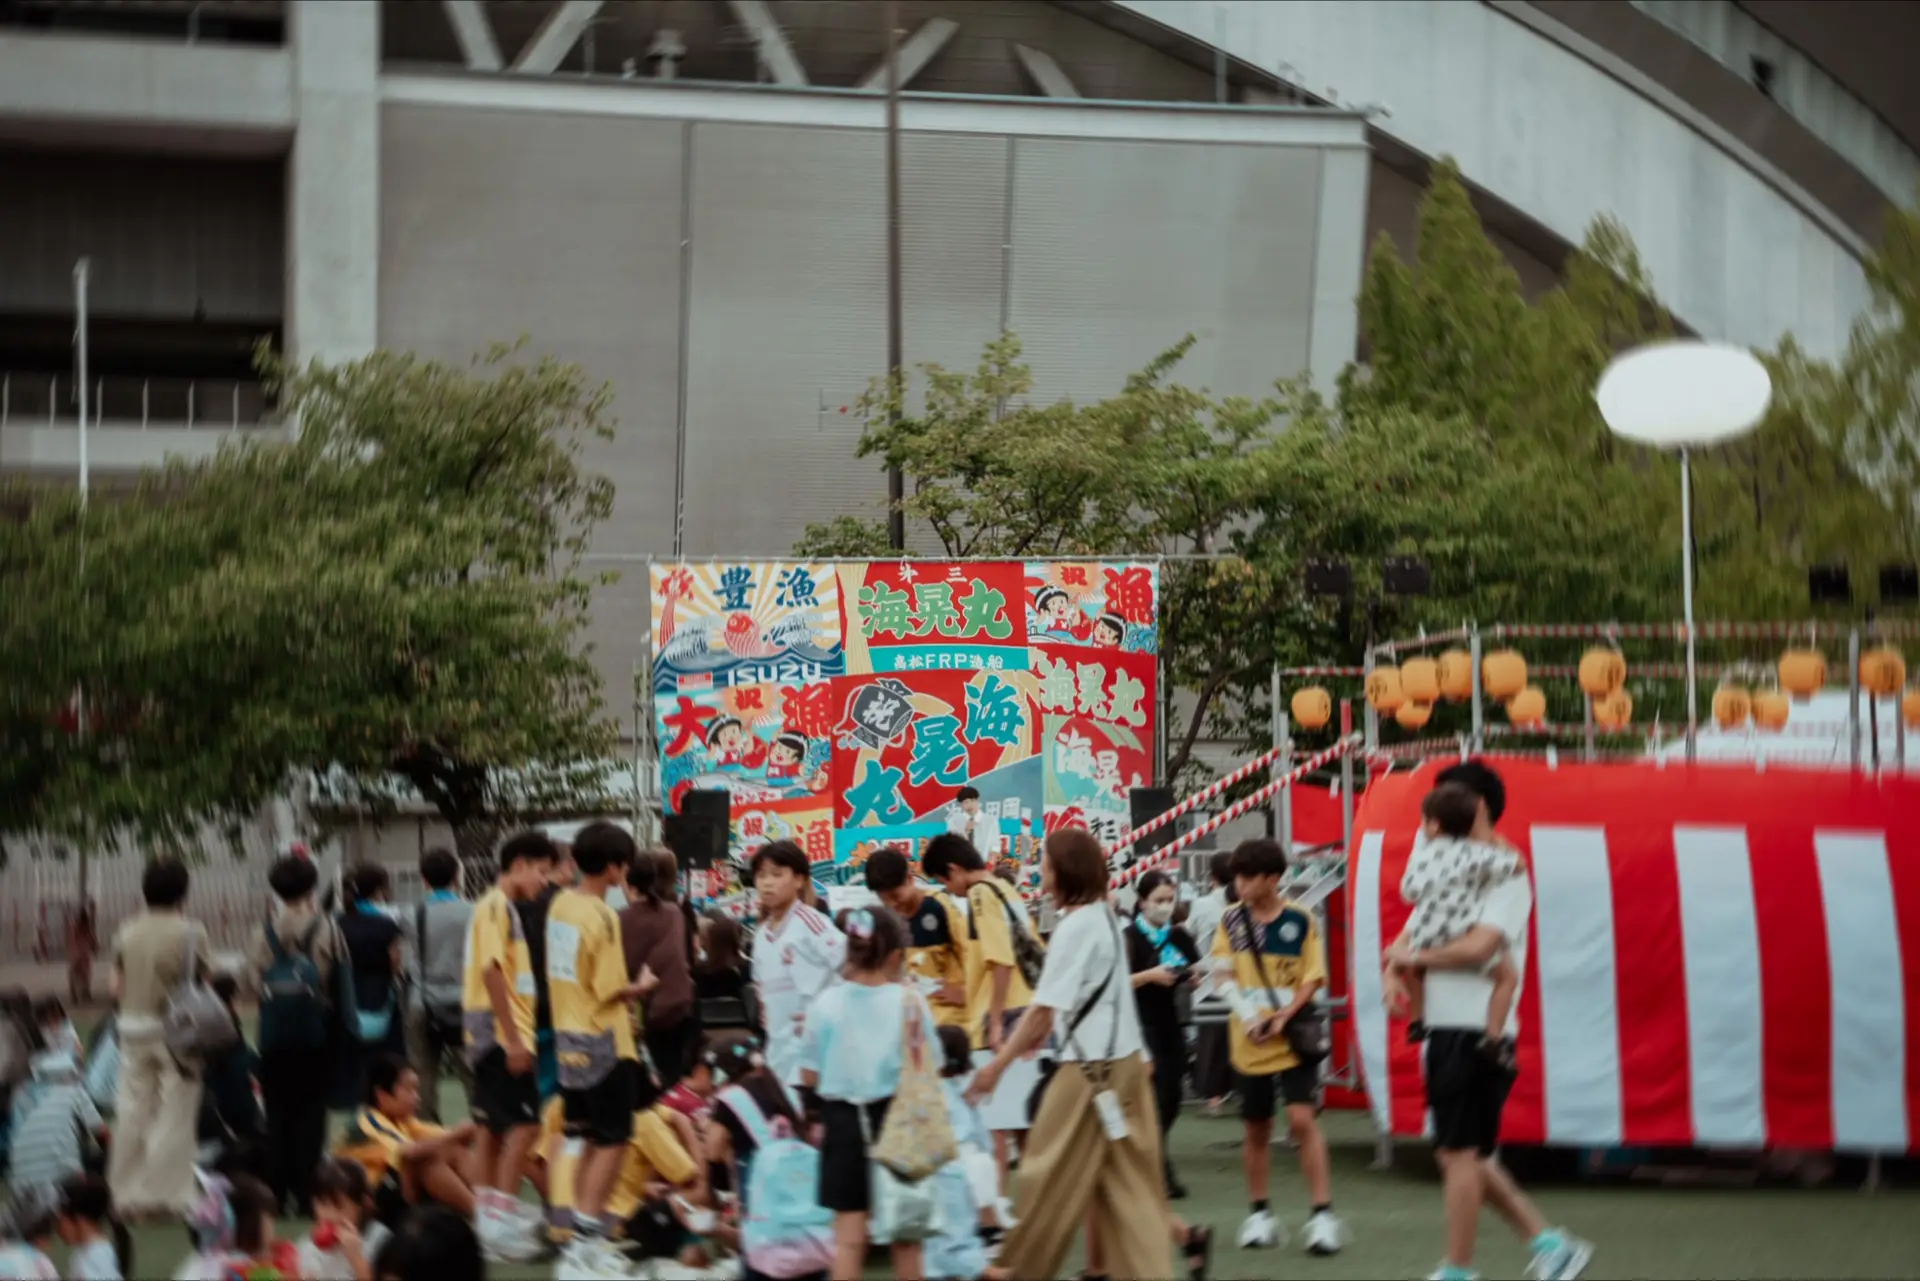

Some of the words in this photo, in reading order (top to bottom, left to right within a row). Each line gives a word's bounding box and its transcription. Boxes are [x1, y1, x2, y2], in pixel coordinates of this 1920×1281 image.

[713, 566, 819, 612] 豊漁
[858, 577, 1014, 640] 海晃丸
[727, 662, 822, 687] ISUZU
[1038, 655, 1147, 727] 海晃丸
